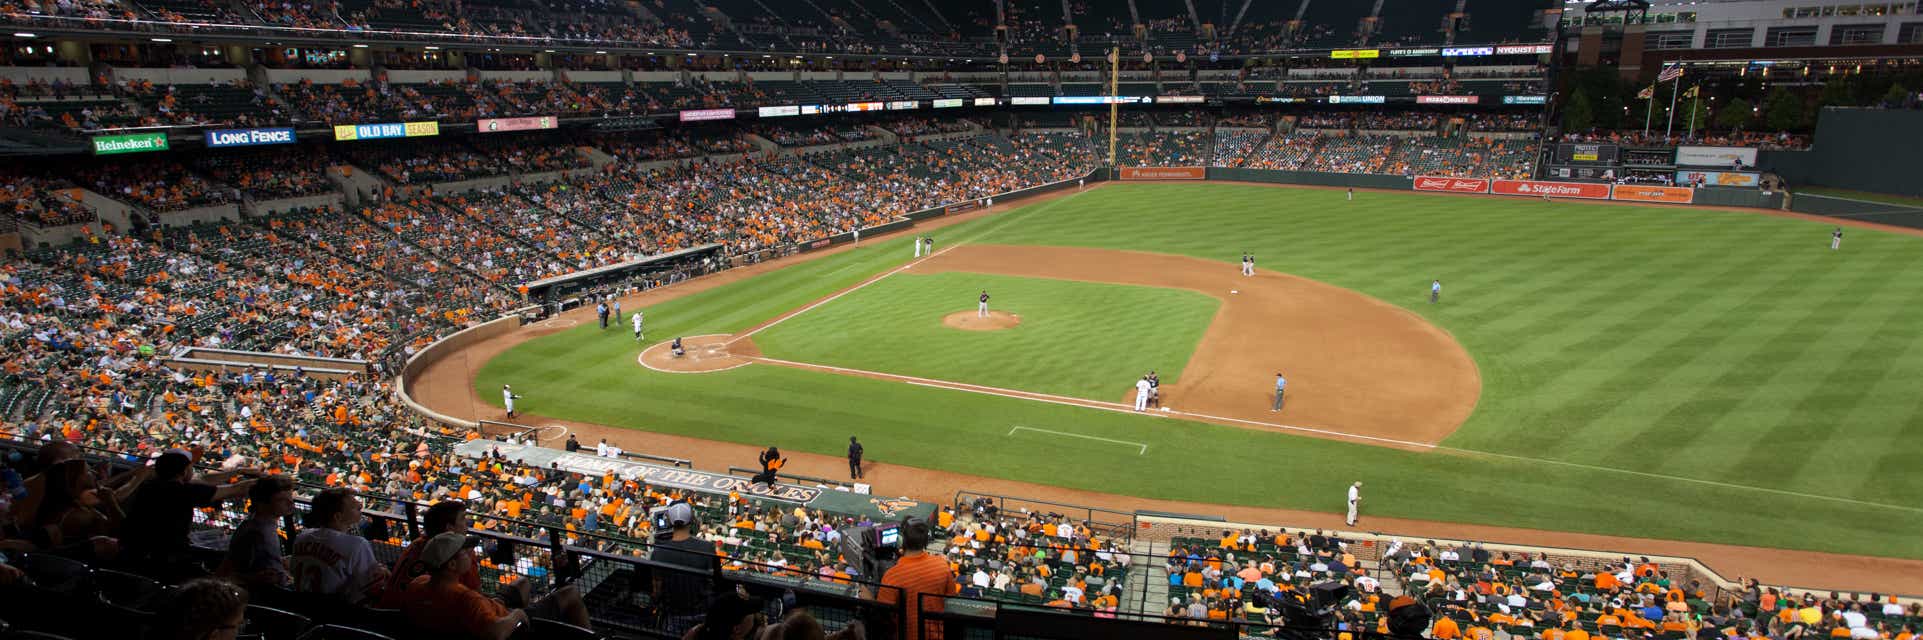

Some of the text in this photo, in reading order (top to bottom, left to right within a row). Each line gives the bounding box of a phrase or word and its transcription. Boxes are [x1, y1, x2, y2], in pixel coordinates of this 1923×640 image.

[1362, 95, 1385, 103] UNION
[212, 130, 291, 144] LONG FENCE
[359, 125, 381, 138] OLD
[382, 124, 403, 137] BAY
[95, 138, 152, 151] Heineken
[660, 467, 713, 487] THE
